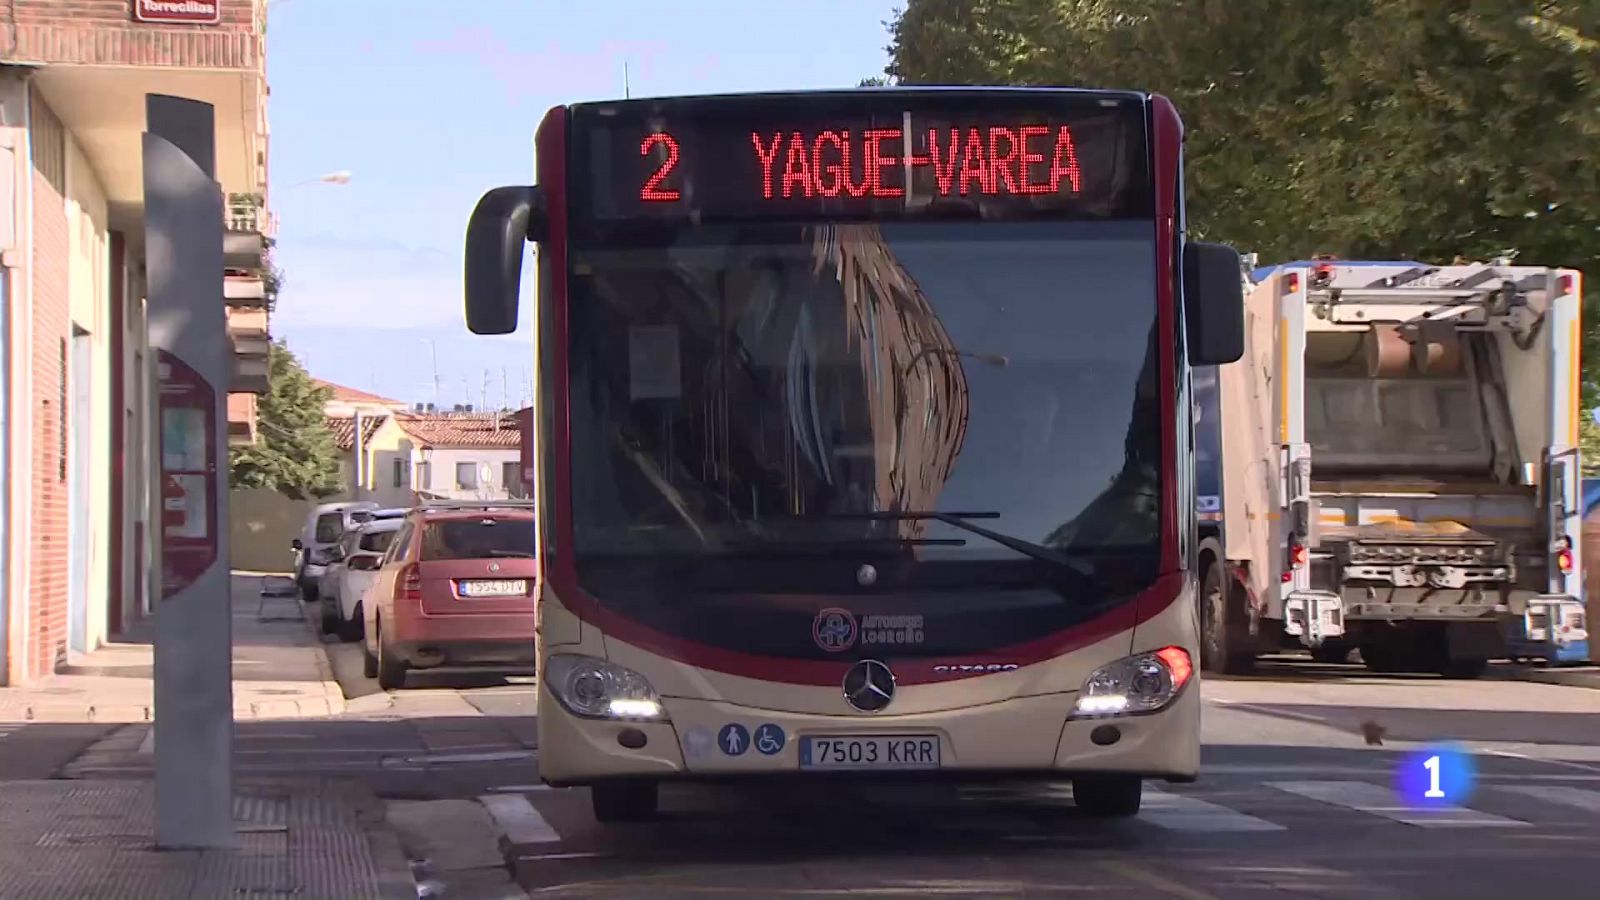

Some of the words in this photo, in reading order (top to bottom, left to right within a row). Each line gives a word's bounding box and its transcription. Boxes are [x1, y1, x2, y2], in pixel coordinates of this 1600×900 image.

[143, 0, 215, 13] Torrecillas
[640, 131, 680, 200] 2
[817, 740, 878, 763] 7503
[887, 740, 933, 763] KRR
